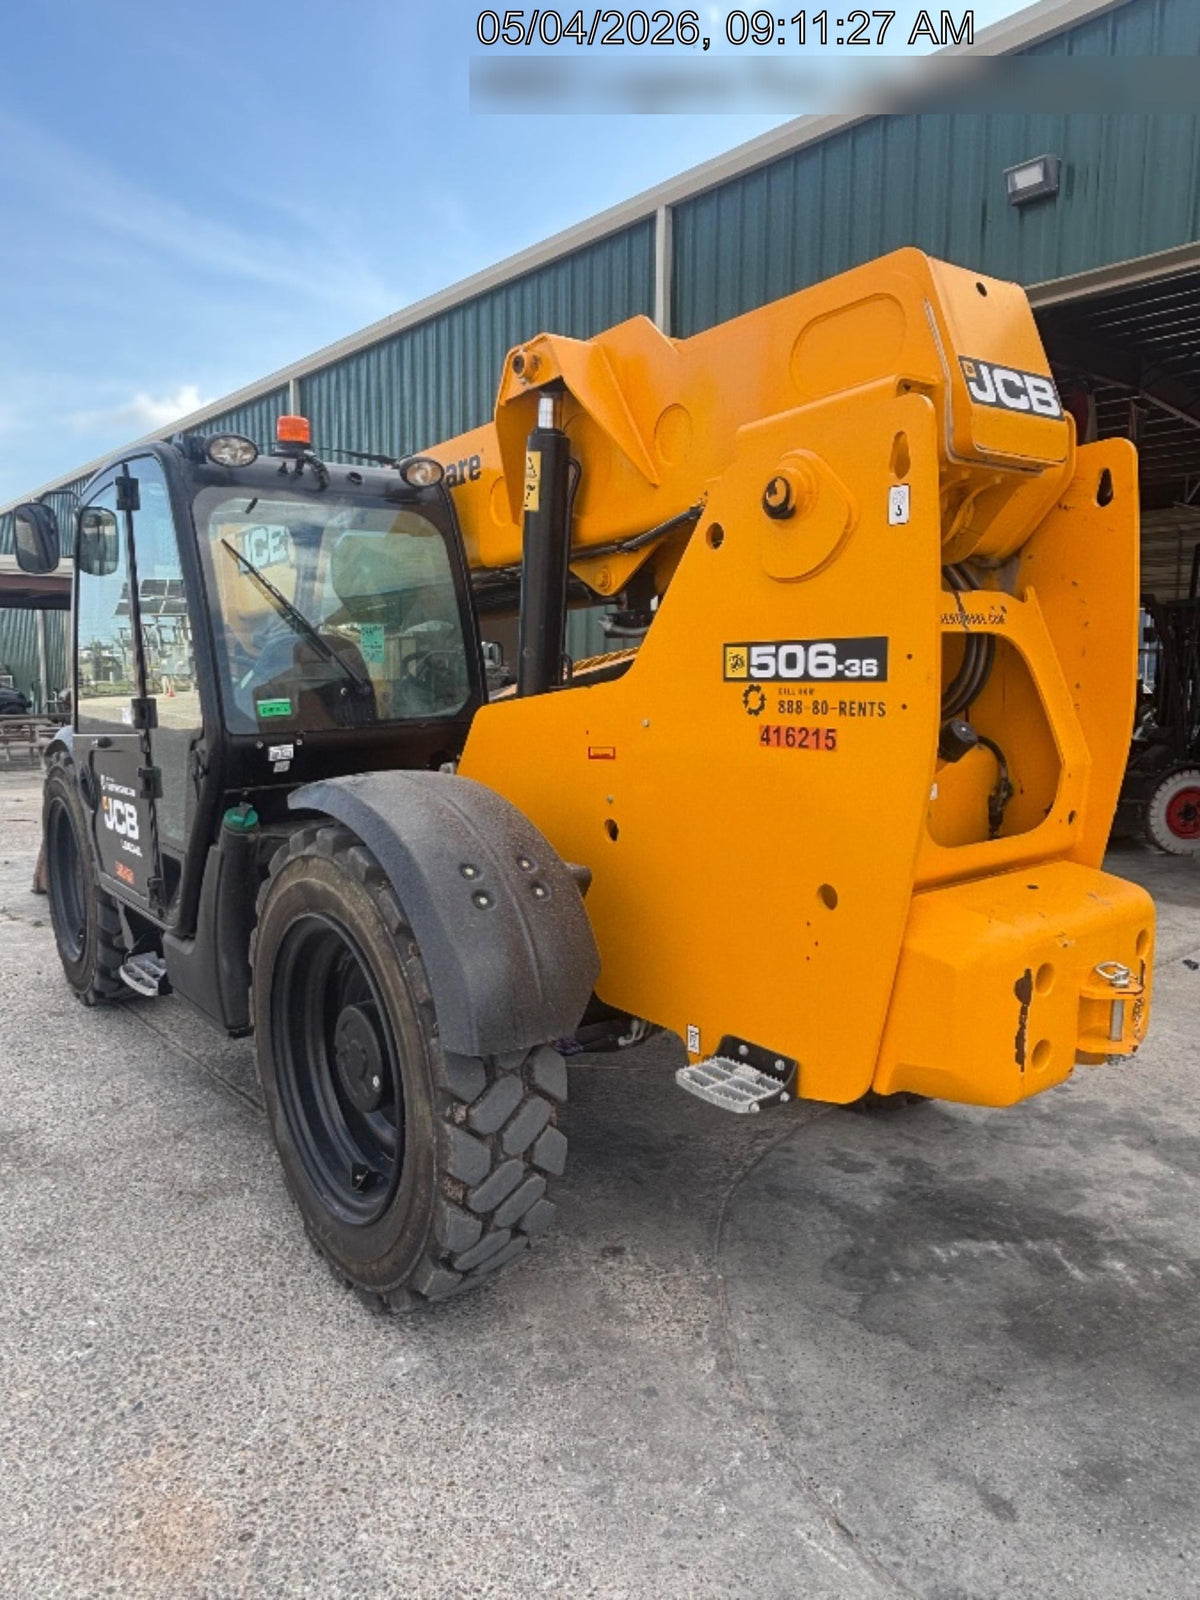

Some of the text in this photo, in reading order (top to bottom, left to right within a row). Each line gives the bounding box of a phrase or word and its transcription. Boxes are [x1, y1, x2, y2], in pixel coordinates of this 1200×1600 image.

[967, 364, 1061, 417] JCB
[750, 644, 878, 678] 506-36
[761, 726, 837, 750] 416215
[103, 797, 138, 839] JCB
